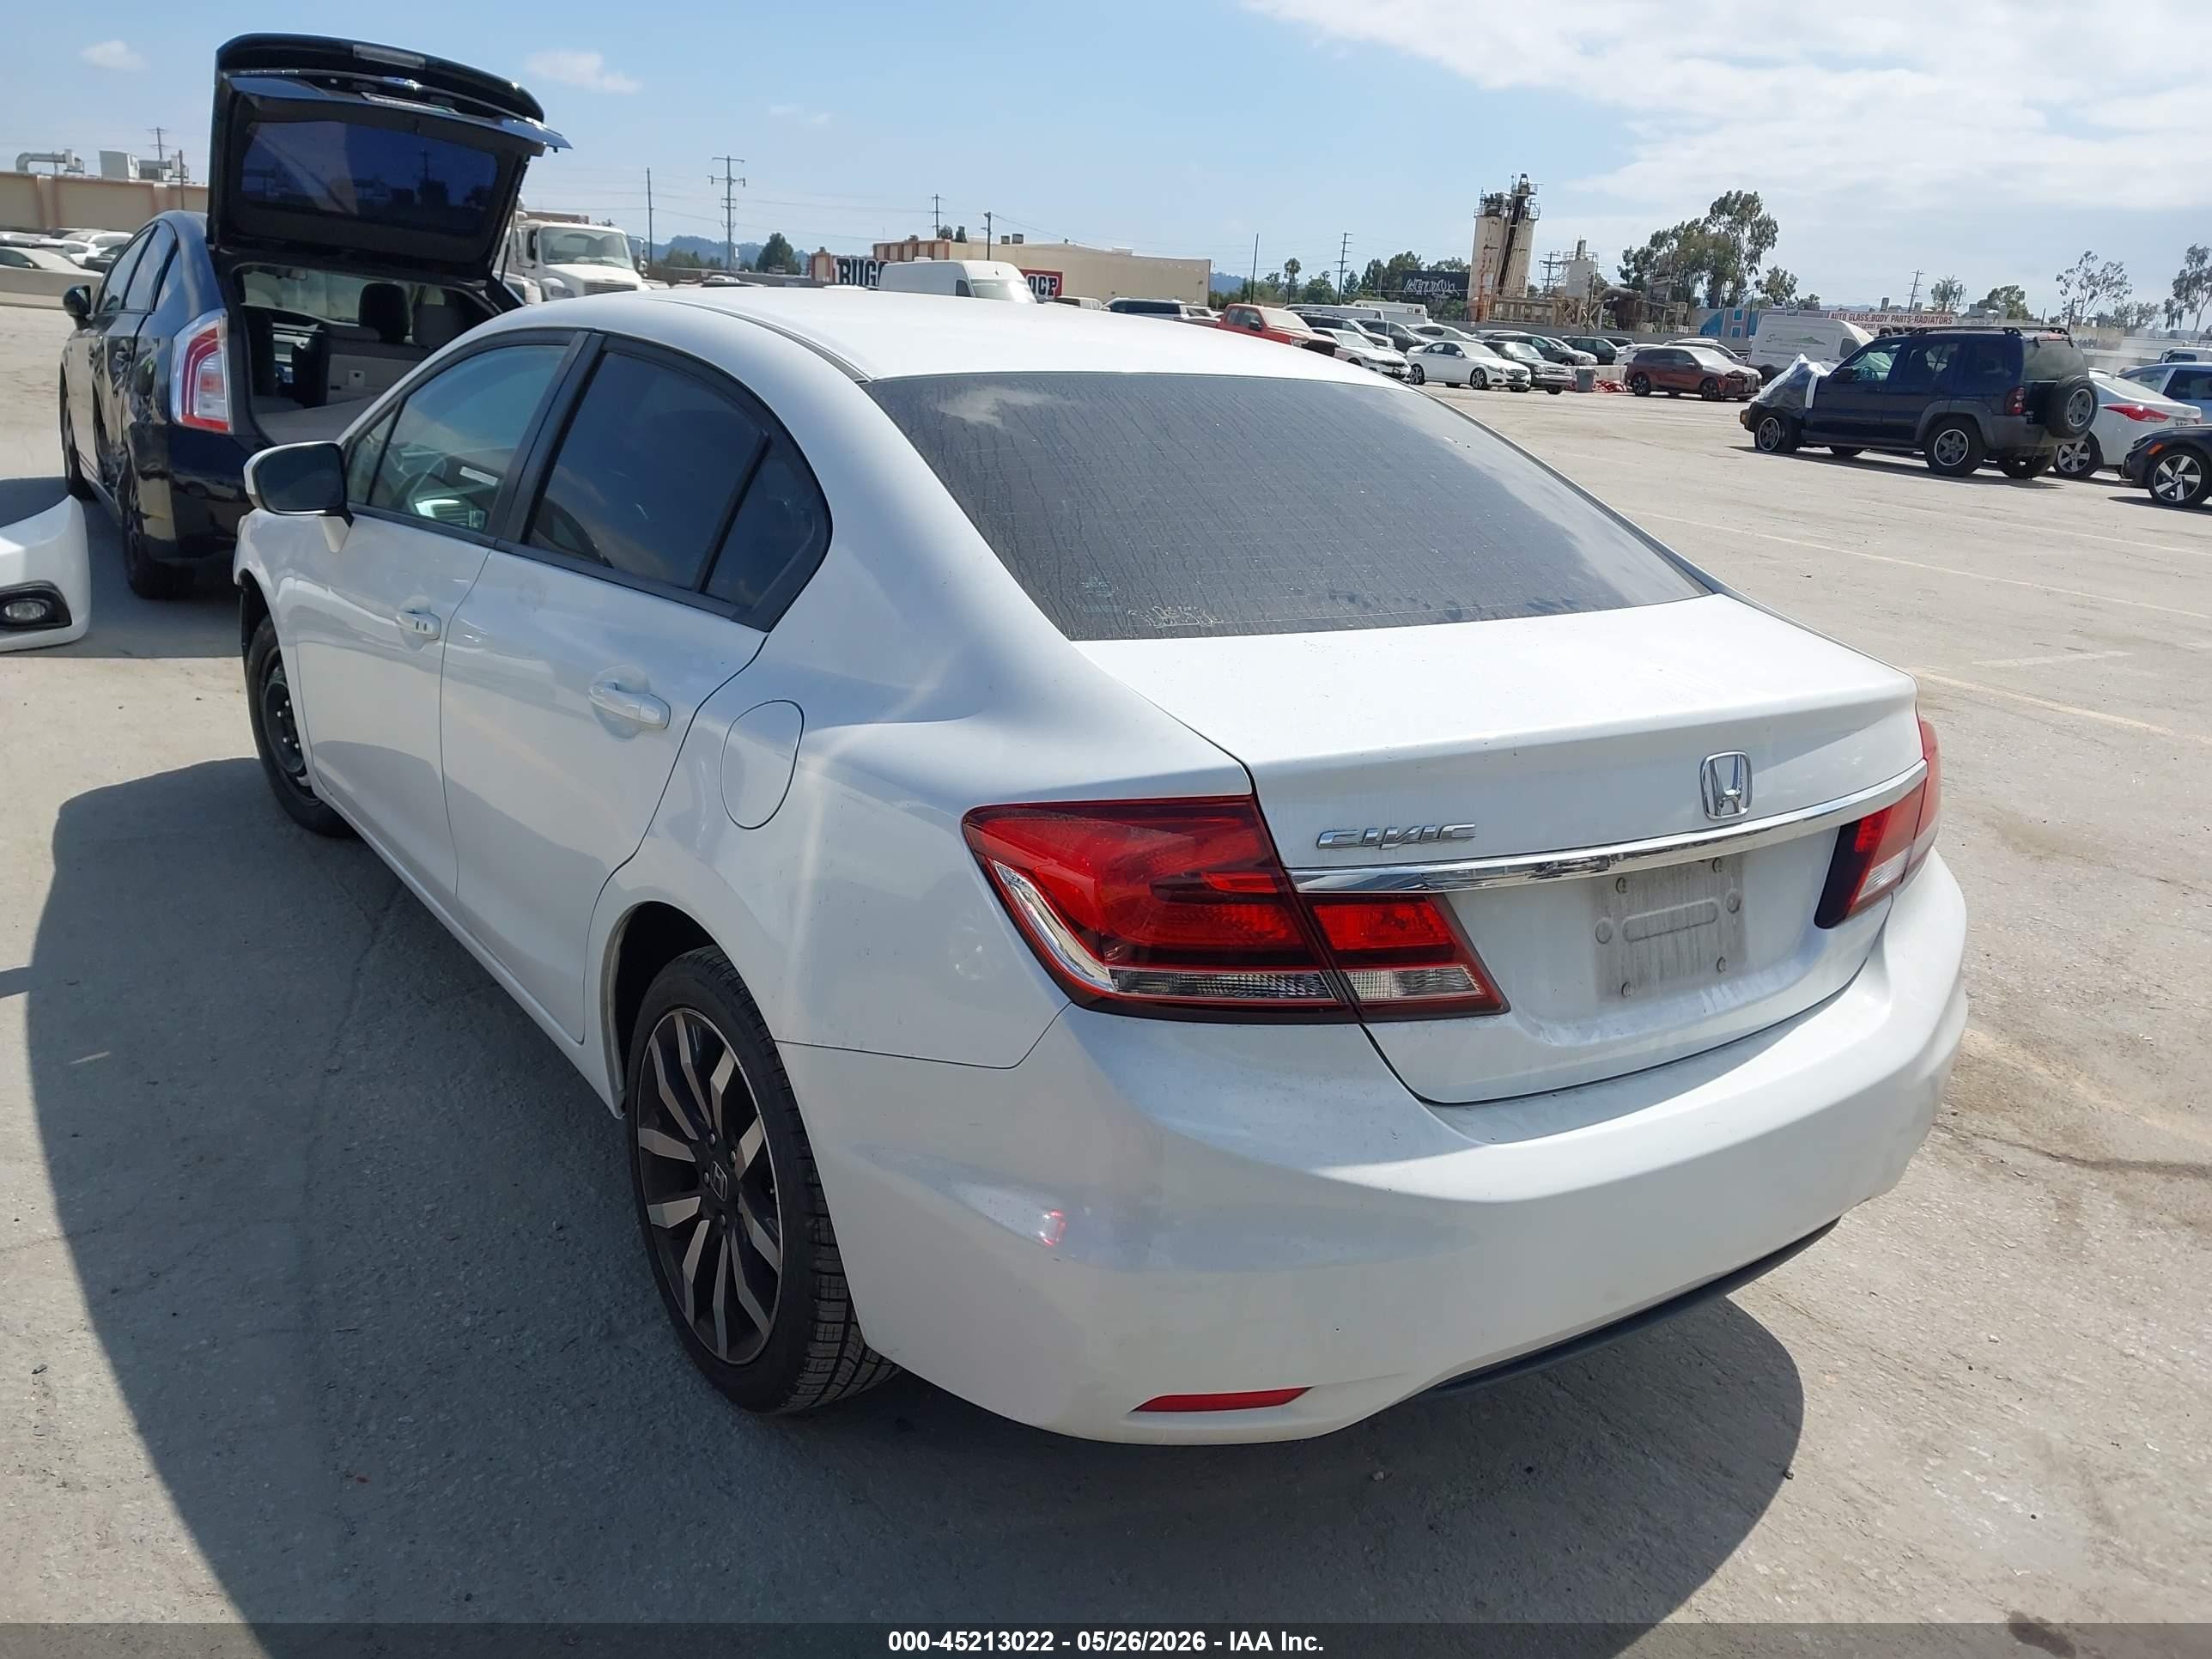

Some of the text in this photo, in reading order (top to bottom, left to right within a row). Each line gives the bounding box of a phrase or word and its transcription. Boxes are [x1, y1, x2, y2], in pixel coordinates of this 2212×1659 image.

[1830, 312, 1846, 321] AUTO
[1890, 314, 1953, 325] PARTS-RADIATORS
[1316, 823, 1478, 850] CIVIC
